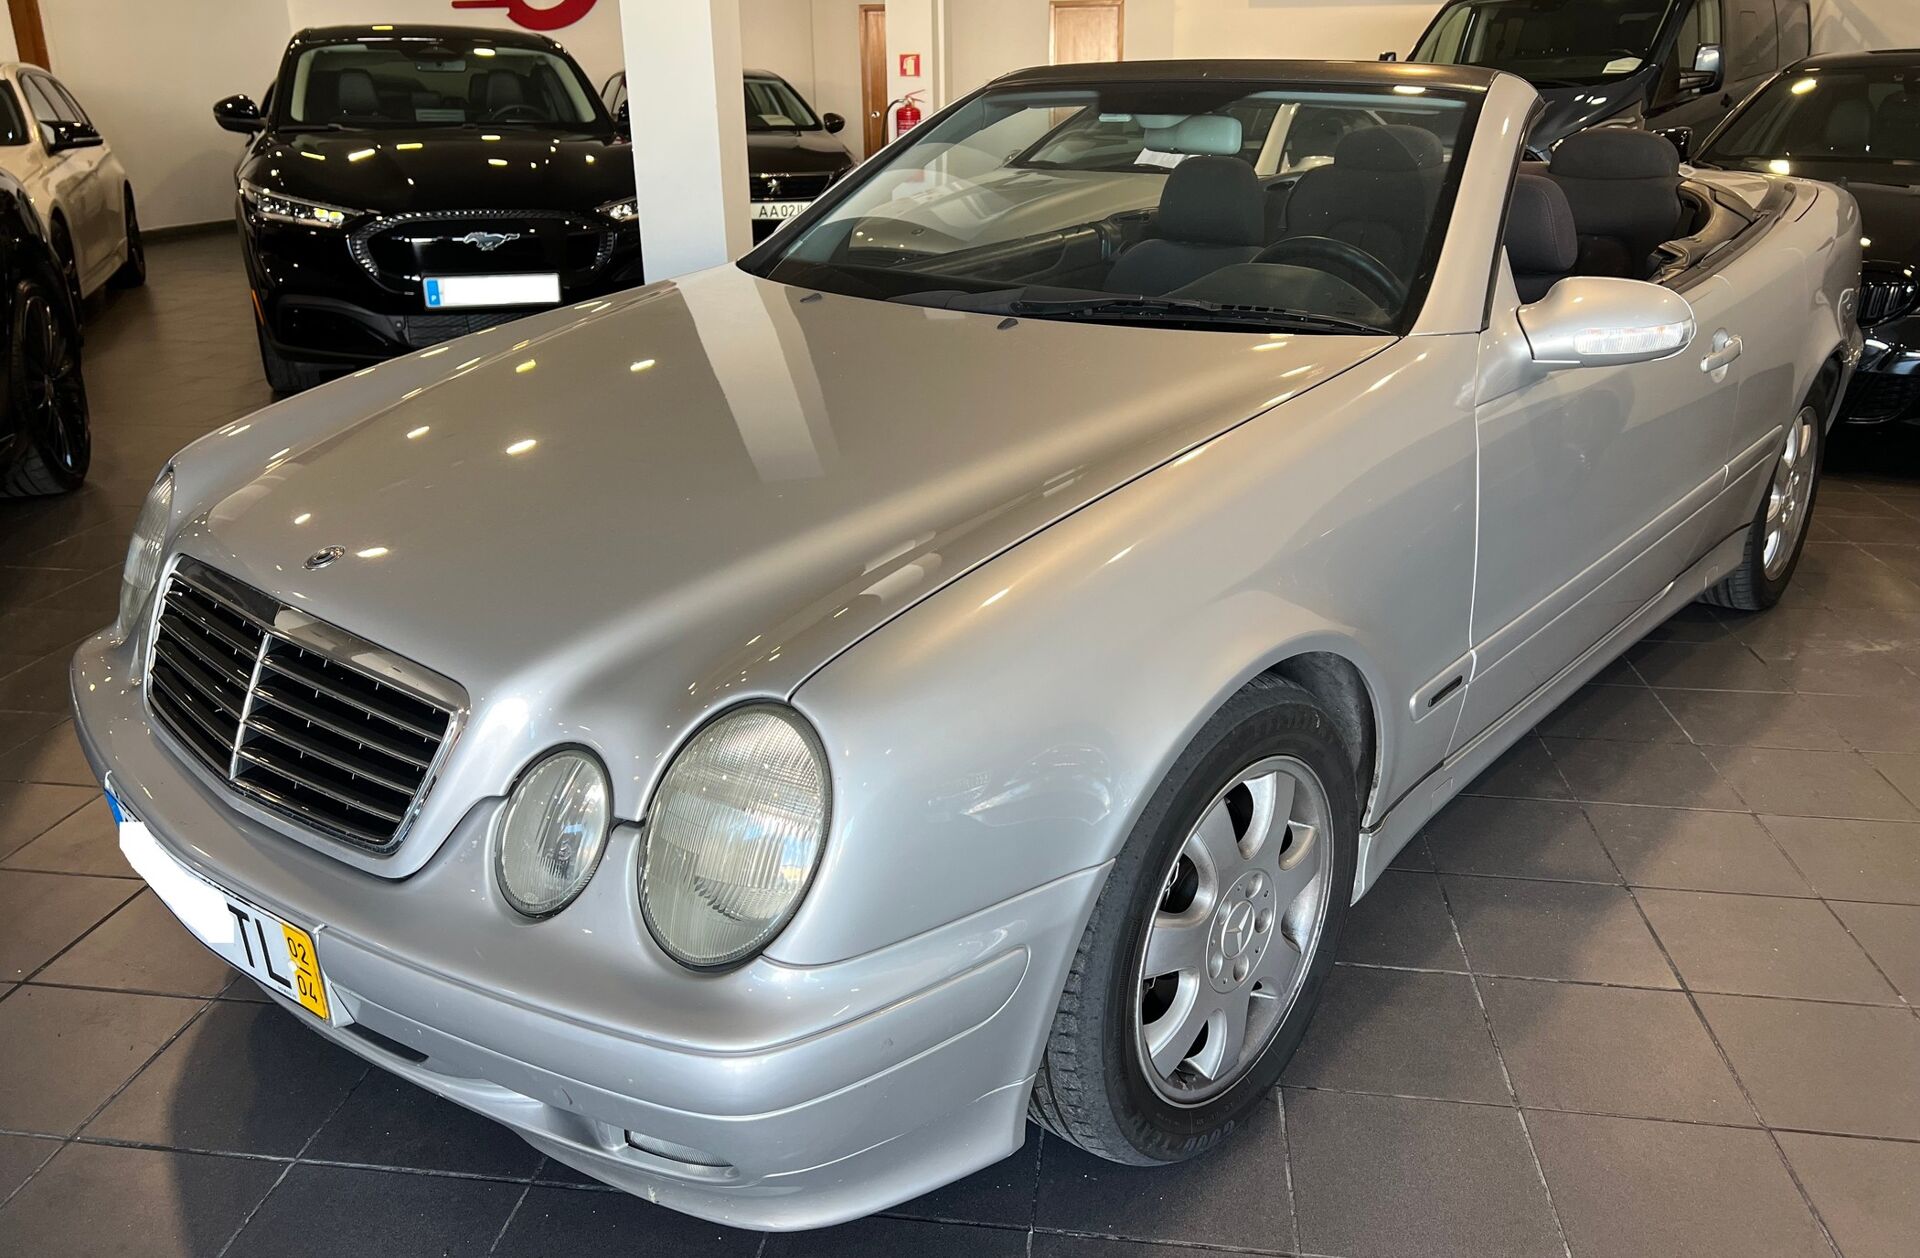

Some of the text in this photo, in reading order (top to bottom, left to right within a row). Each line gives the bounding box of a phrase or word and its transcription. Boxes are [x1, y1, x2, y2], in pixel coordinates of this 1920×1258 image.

[226, 902, 293, 990] TL
[286, 936, 310, 967] 02
[297, 974, 319, 1004] 04
